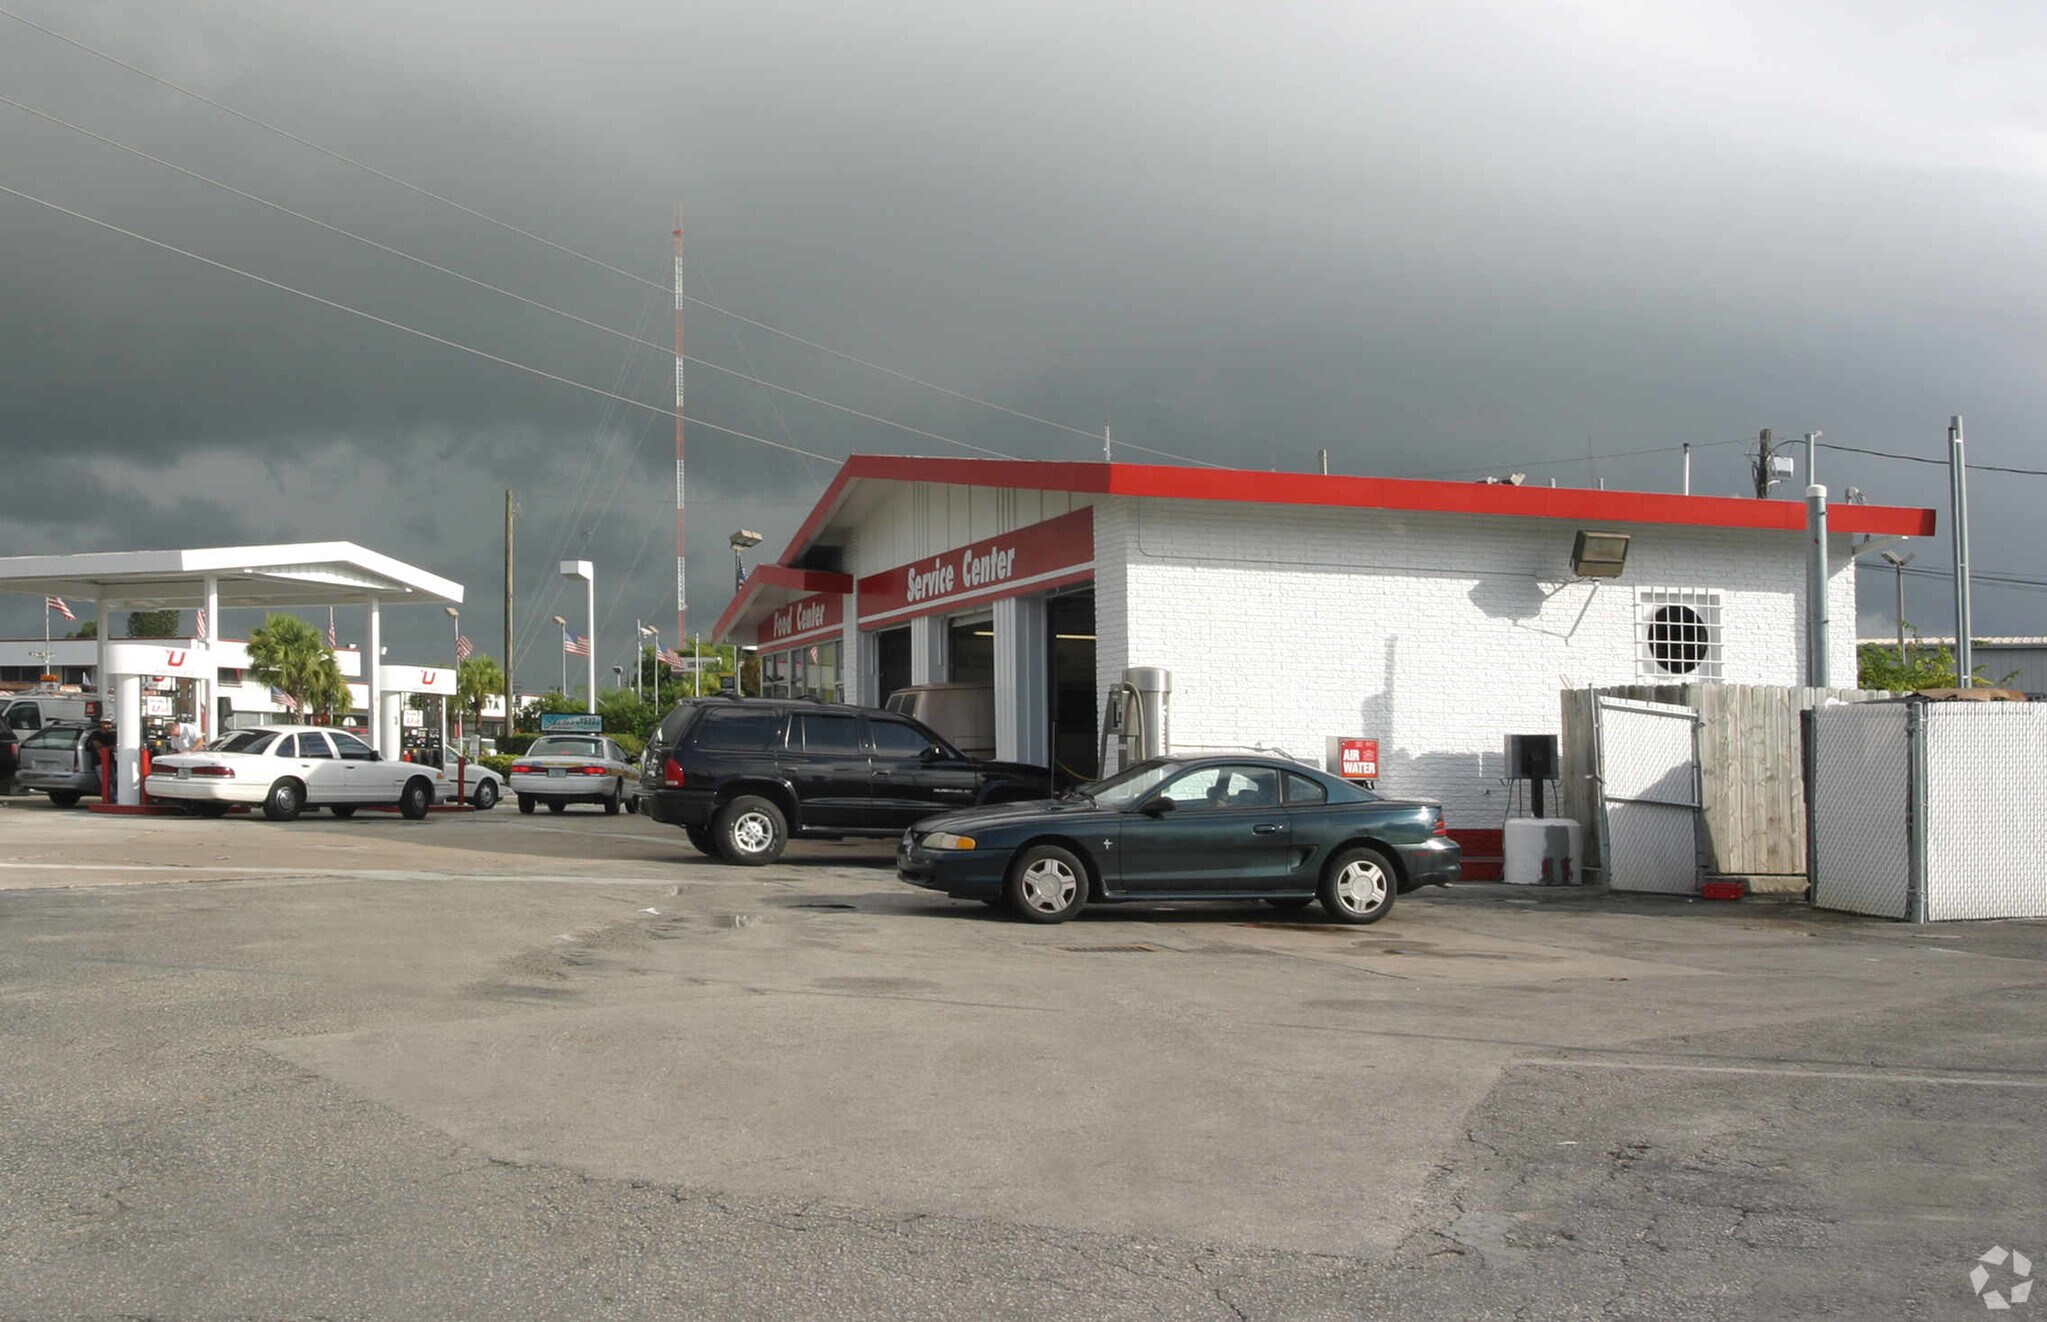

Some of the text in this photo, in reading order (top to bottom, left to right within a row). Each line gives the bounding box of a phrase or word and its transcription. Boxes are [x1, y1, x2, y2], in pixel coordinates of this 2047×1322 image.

[907, 546, 1016, 602] Service Center
[773, 602, 826, 638] Food Center
[1343, 749, 1360, 761] AIR
[1343, 761, 1376, 774] WATER
